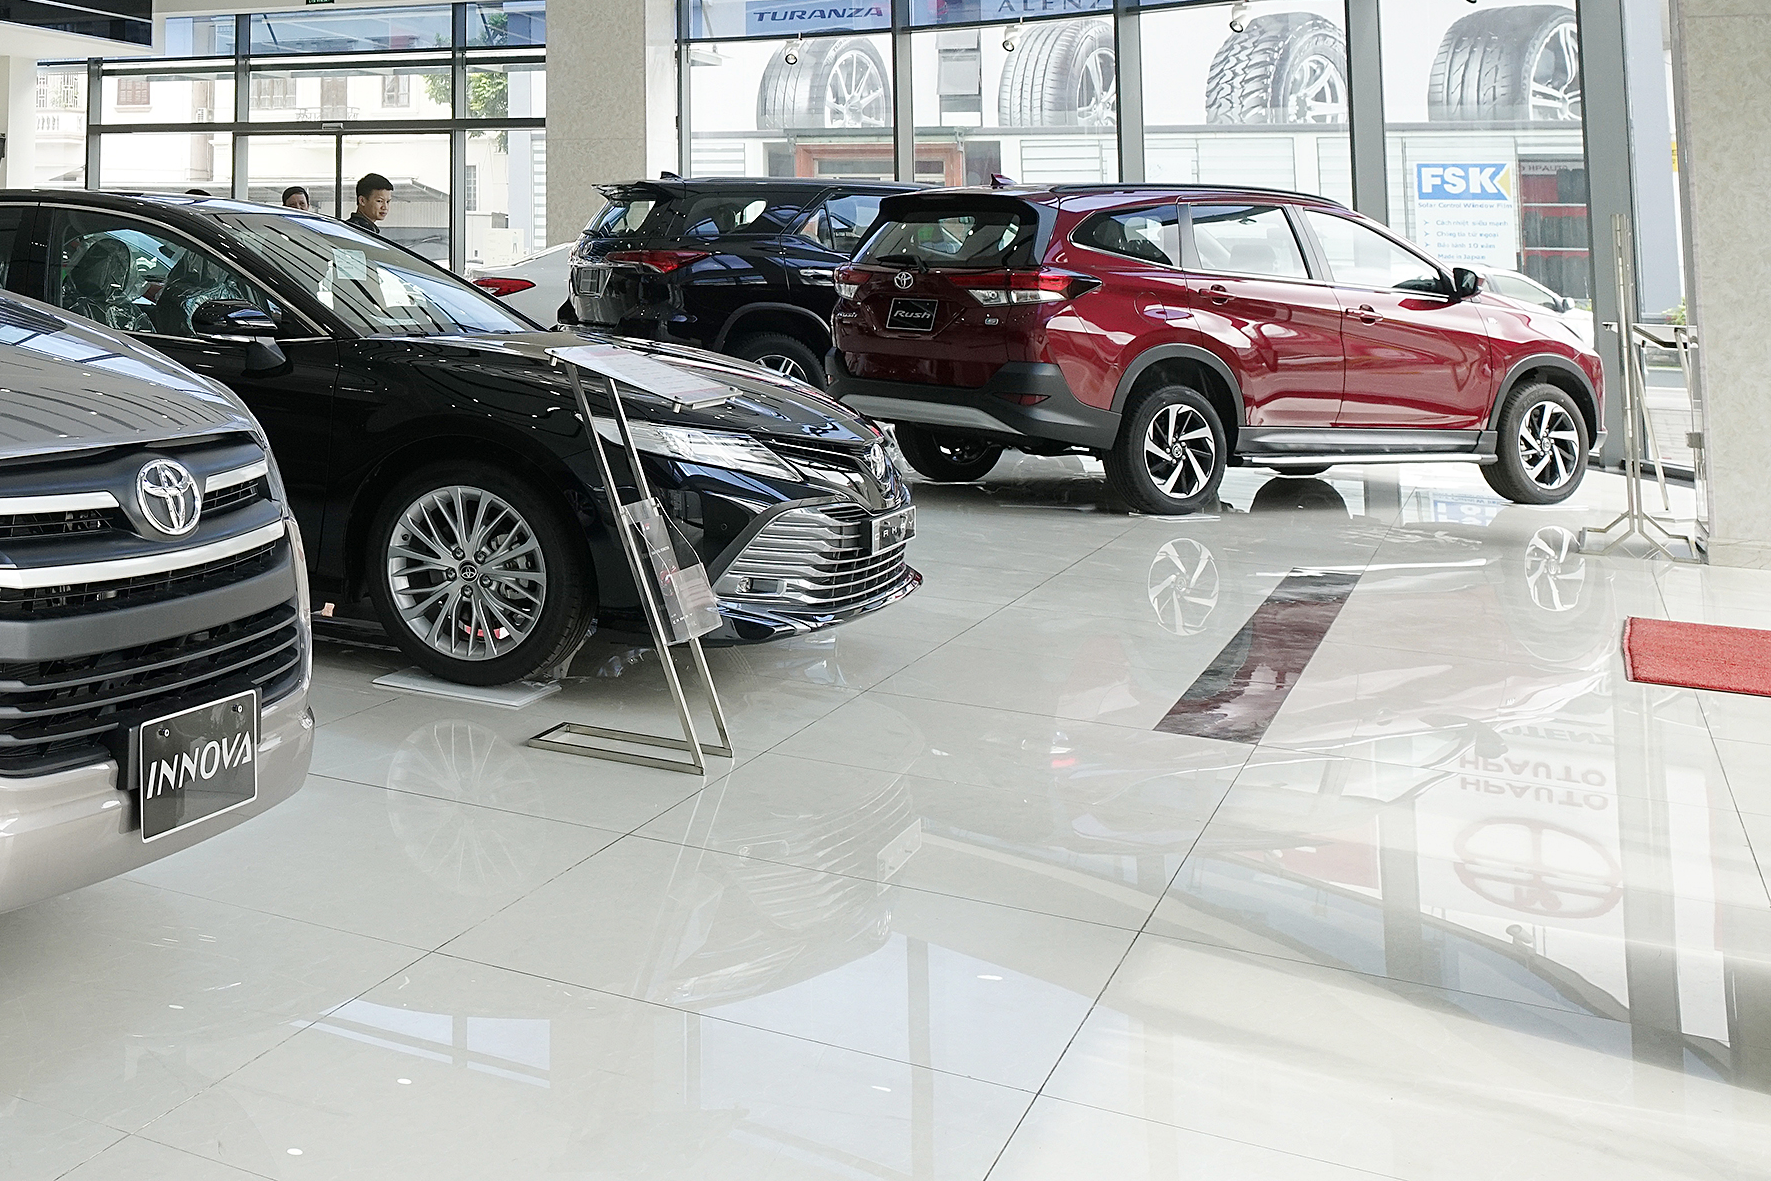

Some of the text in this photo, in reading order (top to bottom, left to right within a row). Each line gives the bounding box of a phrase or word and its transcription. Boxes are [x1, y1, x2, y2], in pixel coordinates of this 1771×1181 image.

[753, 6, 884, 22] TURANZA
[1421, 167, 1498, 194] FSK
[893, 309, 932, 319] Rush
[874, 519, 914, 541] CAMRY
[146, 730, 252, 800] INNOVA
